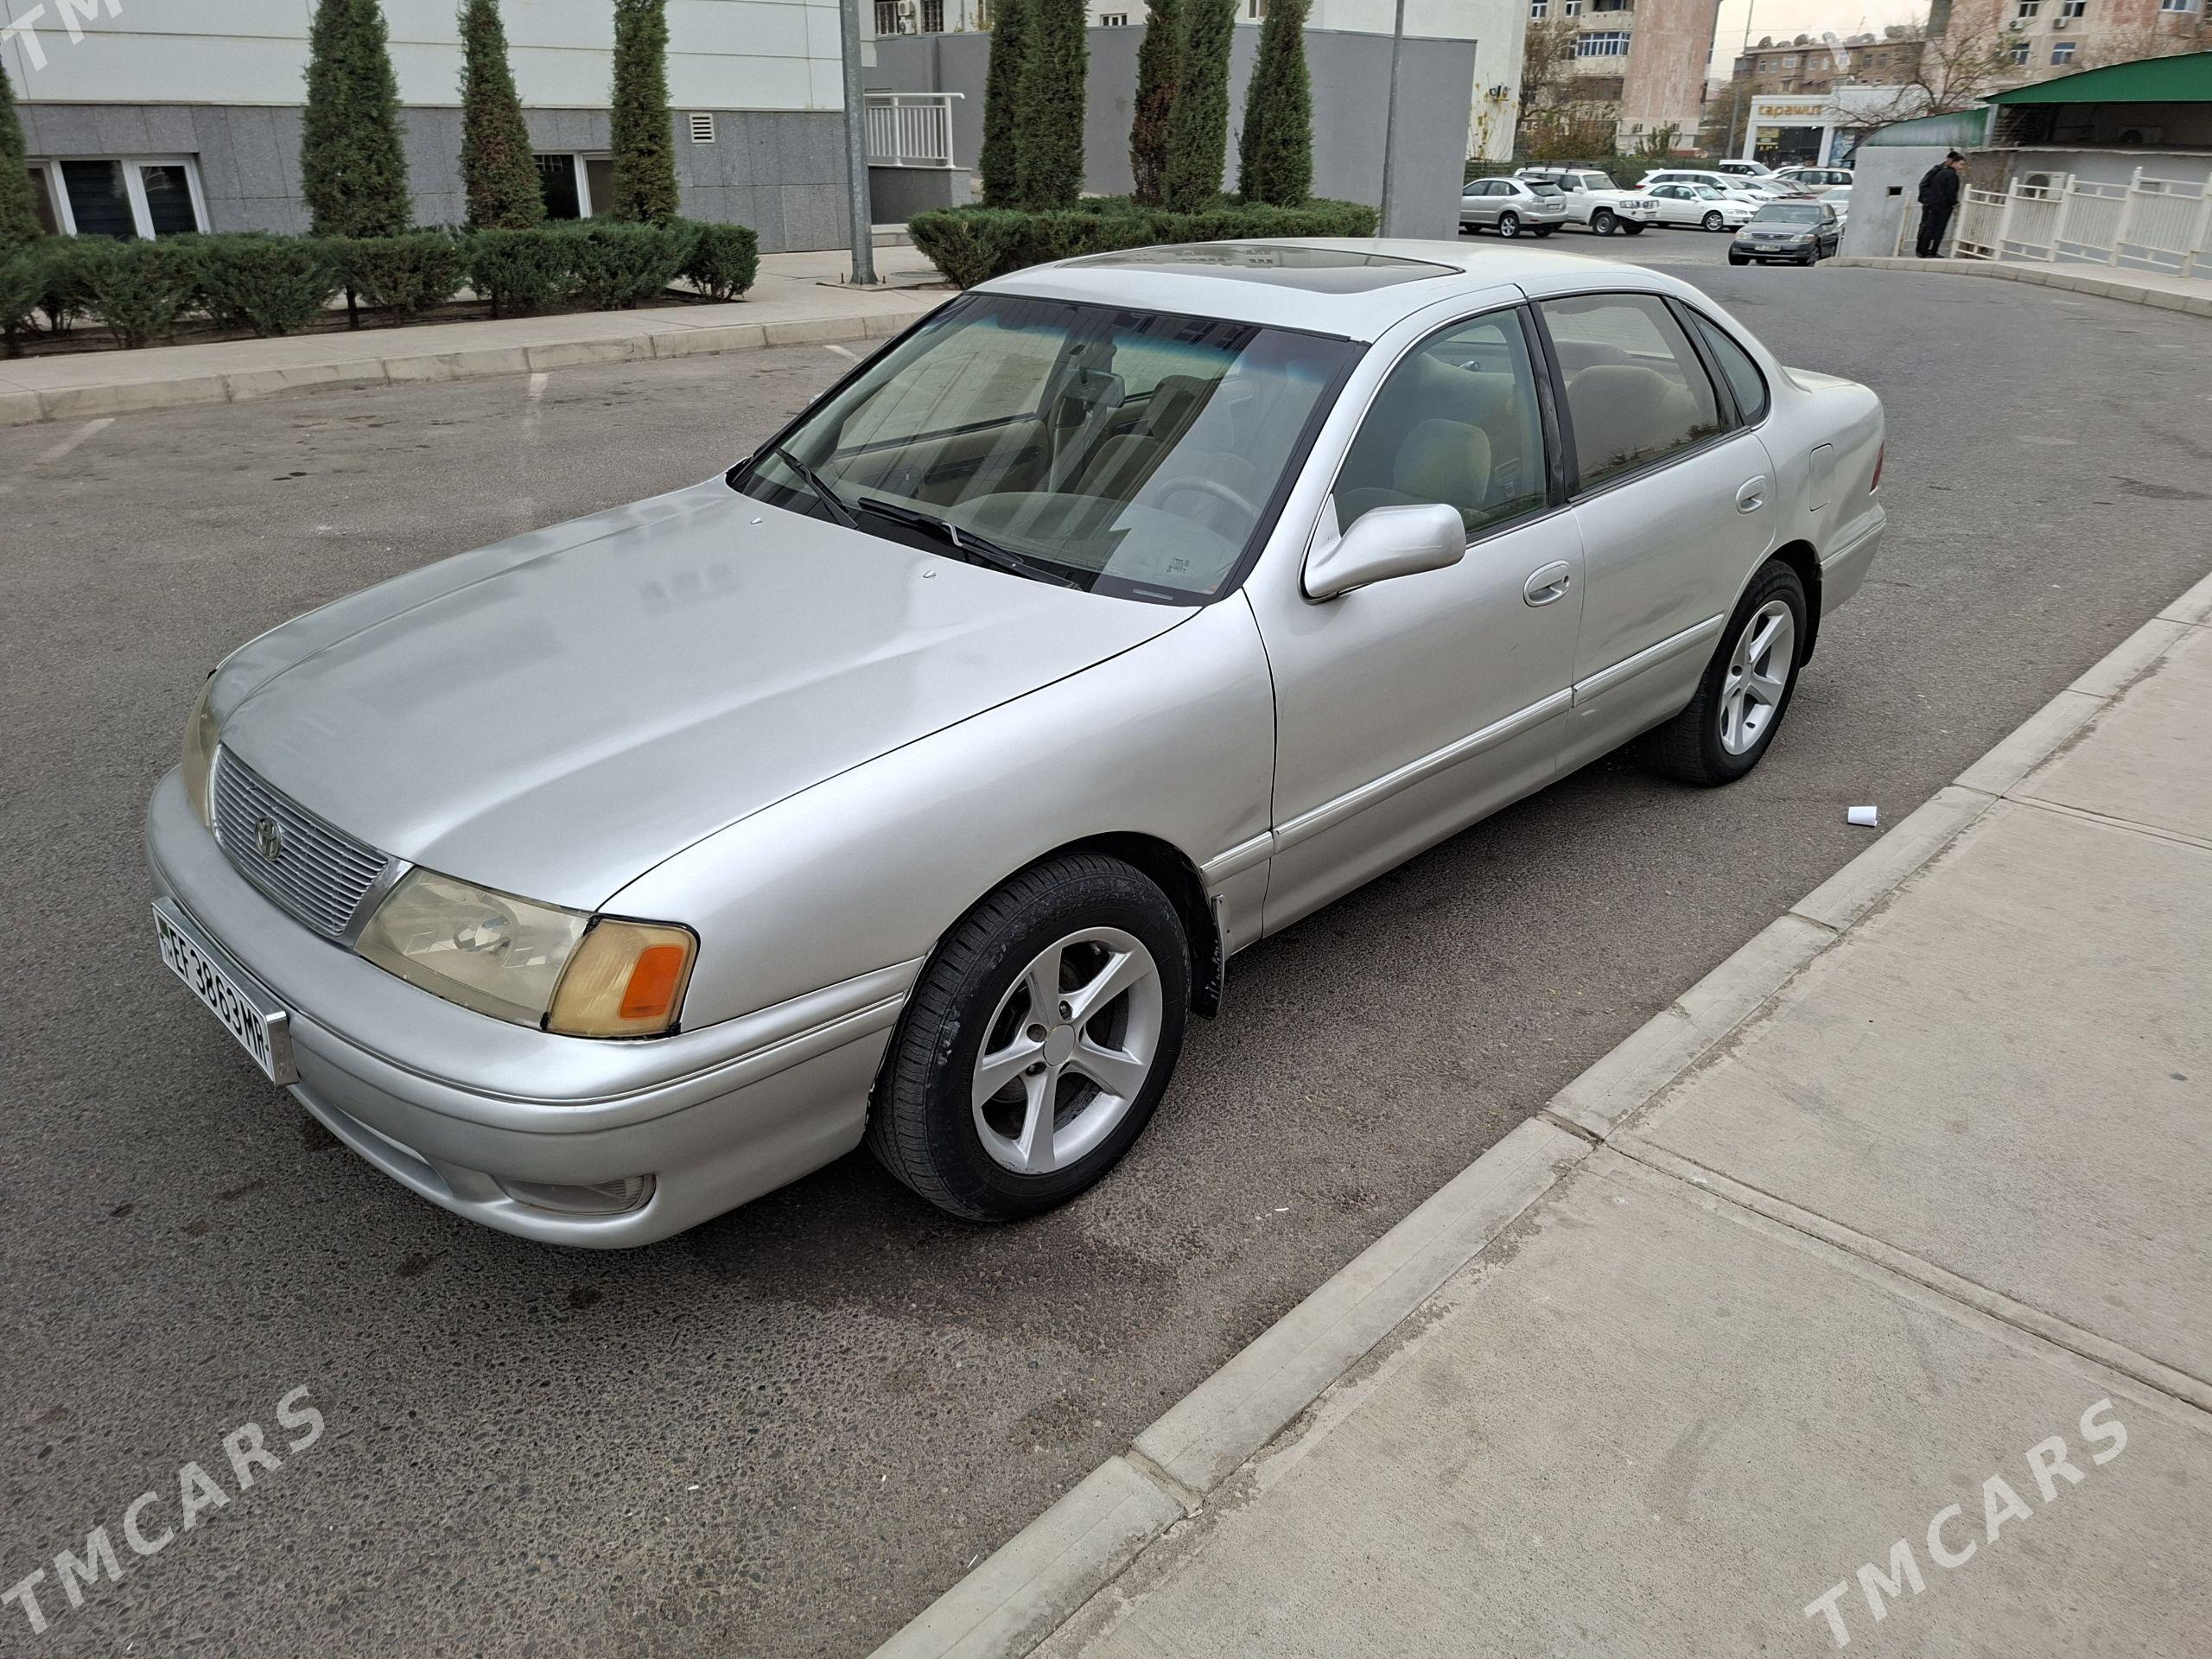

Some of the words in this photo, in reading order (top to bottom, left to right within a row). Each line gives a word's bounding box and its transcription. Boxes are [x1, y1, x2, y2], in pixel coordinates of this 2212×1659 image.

[168, 927, 189, 980] EF
[190, 949, 242, 1036] 3863
[239, 999, 268, 1068] MR
